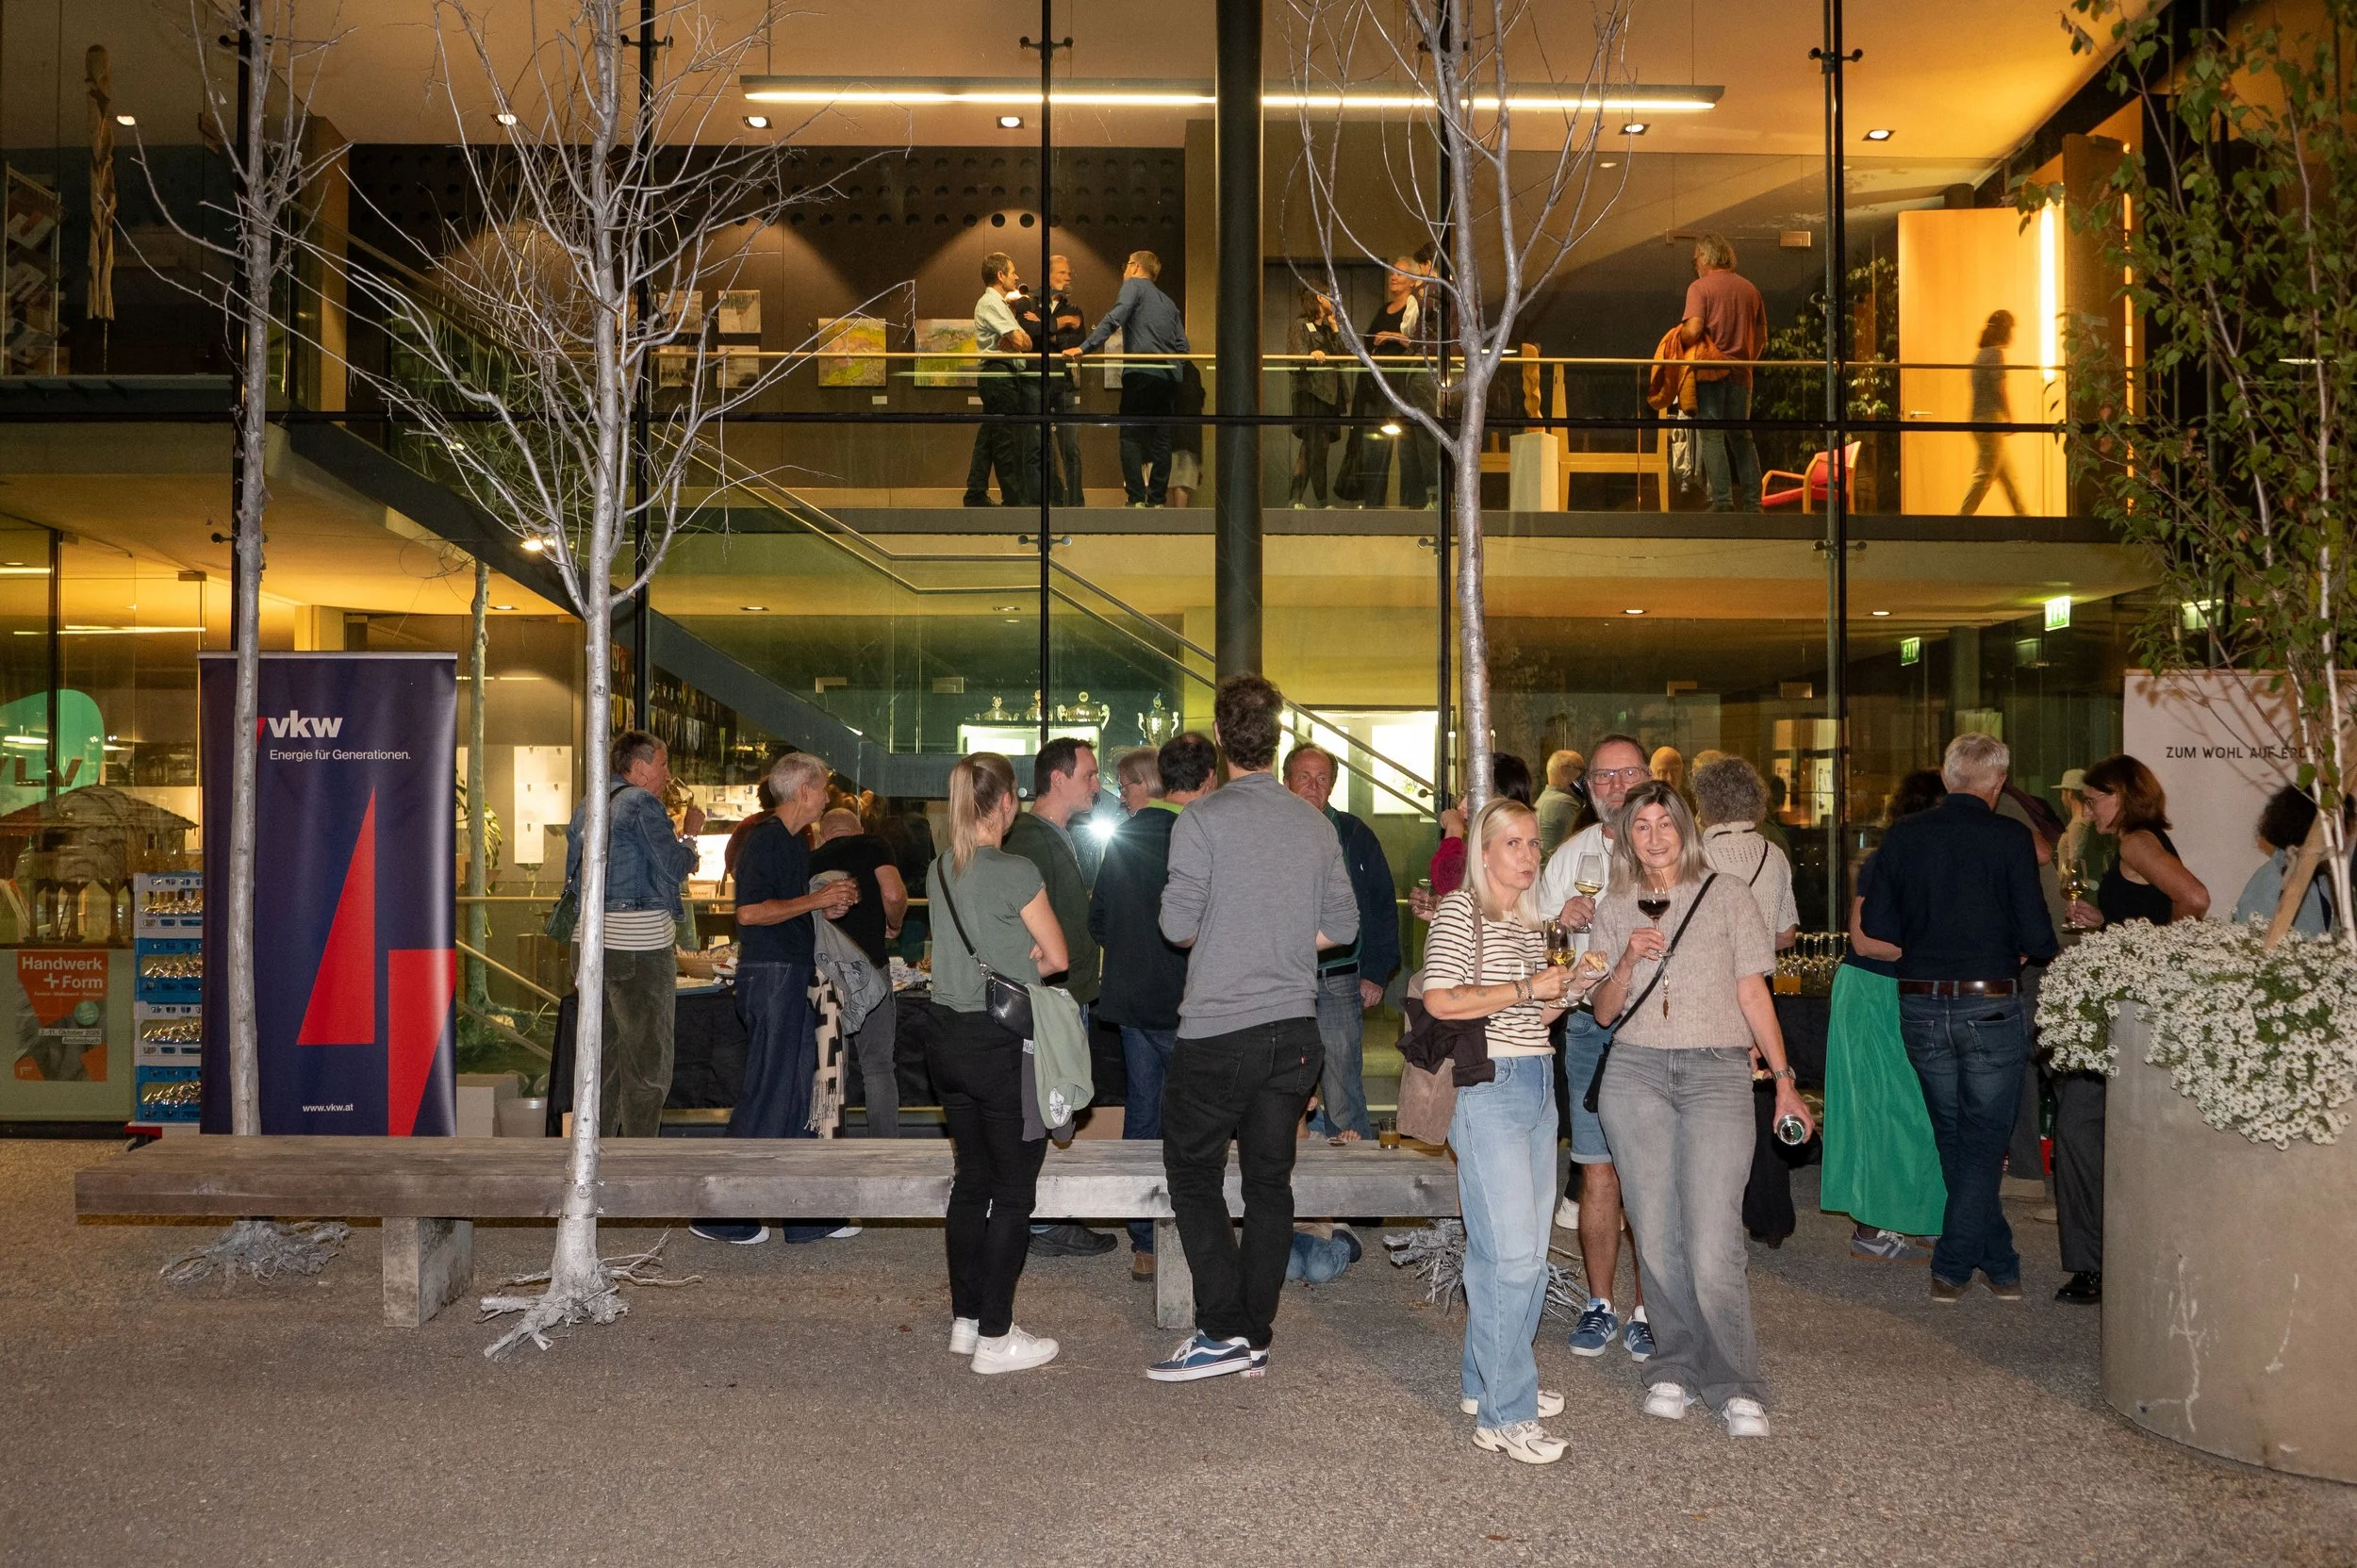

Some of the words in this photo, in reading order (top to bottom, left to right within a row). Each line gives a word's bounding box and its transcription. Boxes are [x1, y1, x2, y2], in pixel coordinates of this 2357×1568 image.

[267, 709, 343, 738] vkw
[270, 749, 313, 762] Energie
[315, 749, 331, 760] für
[332, 749, 411, 760] Generationen.
[2166, 746, 2197, 759] ZUM
[2202, 746, 2243, 759] WOHL
[2250, 746, 2275, 759] AUF
[0, 756, 83, 787] LV
[22, 956, 103, 970] Handwerk
[302, 1103, 354, 1112] www.vkw.at
